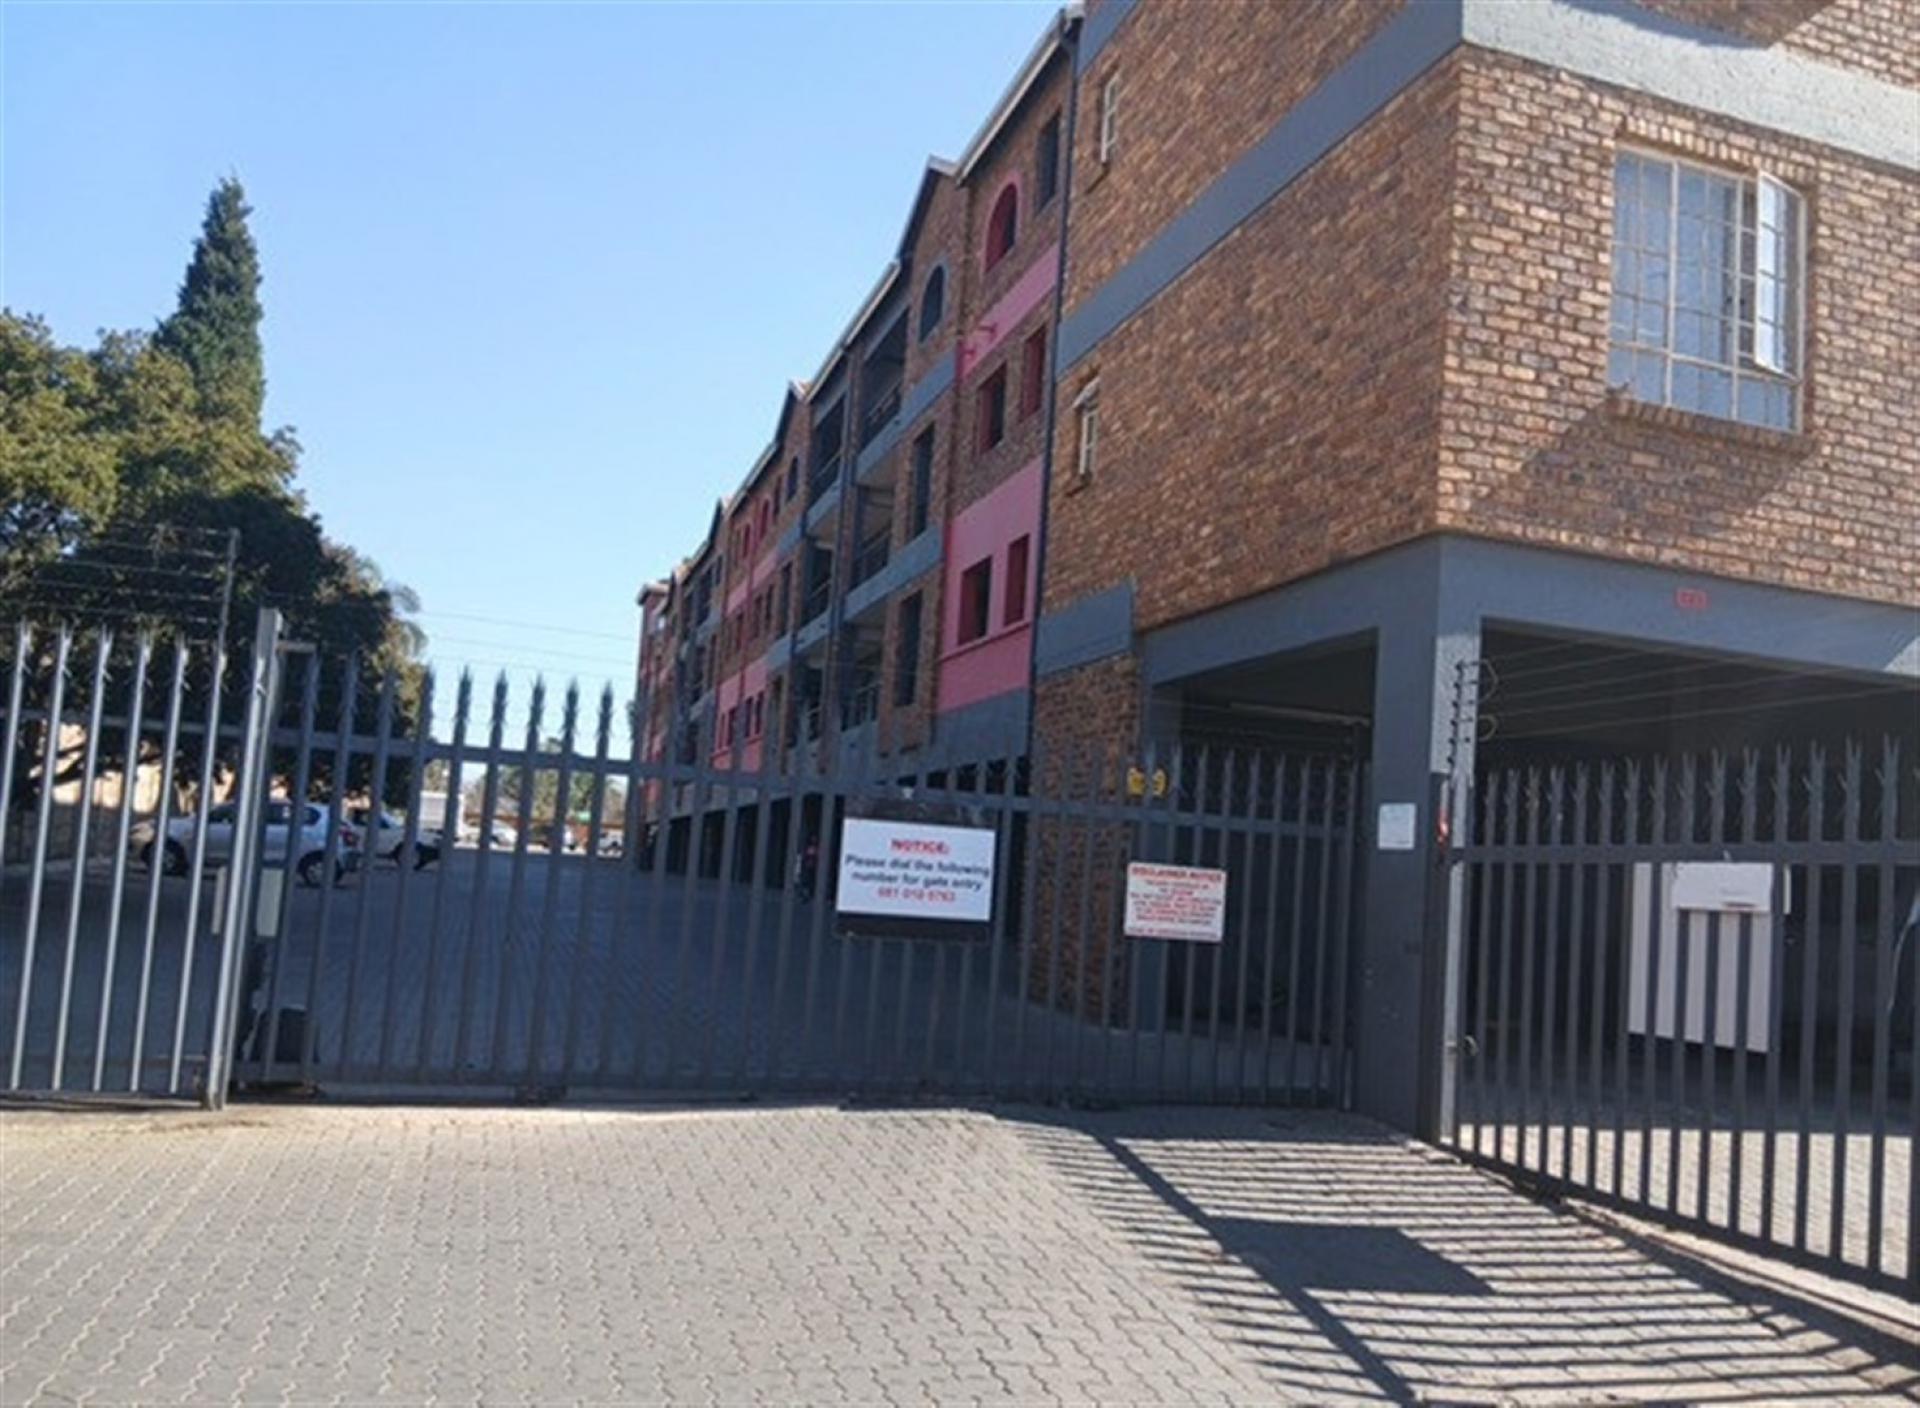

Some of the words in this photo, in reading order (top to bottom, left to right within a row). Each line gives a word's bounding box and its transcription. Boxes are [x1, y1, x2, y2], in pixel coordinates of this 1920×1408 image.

[891, 839, 950, 853] NOTICE:
[845, 855, 885, 867] Please
[890, 858, 911, 869] dial
[914, 860, 933, 871] the
[938, 862, 989, 878] following
[852, 872, 898, 883] number
[903, 874, 919, 884] for
[923, 876, 948, 888] gate
[952, 879, 982, 892] entry
